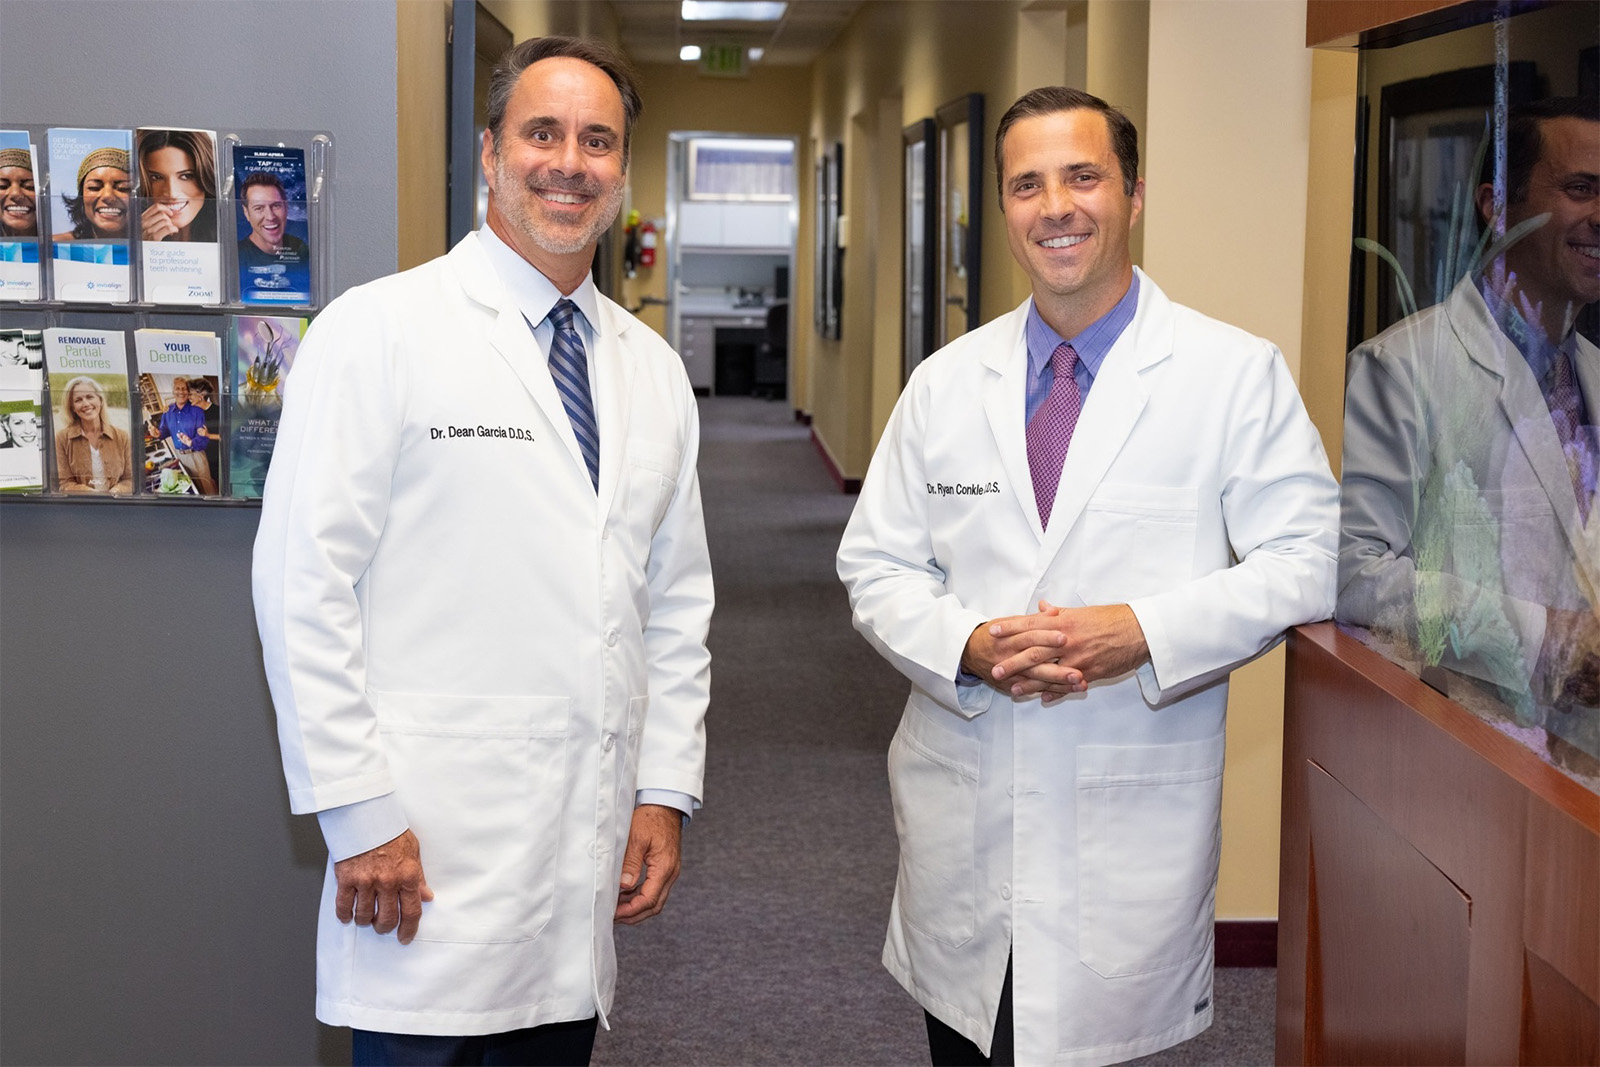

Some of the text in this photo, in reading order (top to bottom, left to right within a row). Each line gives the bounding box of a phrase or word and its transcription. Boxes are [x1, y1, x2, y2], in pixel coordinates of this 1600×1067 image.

[149, 248, 186, 258] Your guide
[149, 256, 199, 265] to professional
[169, 265, 203, 275] whitening
[57, 336, 106, 345] REMOVABLE
[65, 345, 102, 357] Partial
[163, 342, 191, 352] YOUR
[59, 356, 111, 369] Dentures
[149, 349, 208, 365] Dentures
[430, 425, 535, 442] Dr. Dean Garcia D.D.S.
[926, 483, 937, 495] Dr.
[937, 482, 955, 497] Ryan
[955, 483, 984, 496] Conkle
